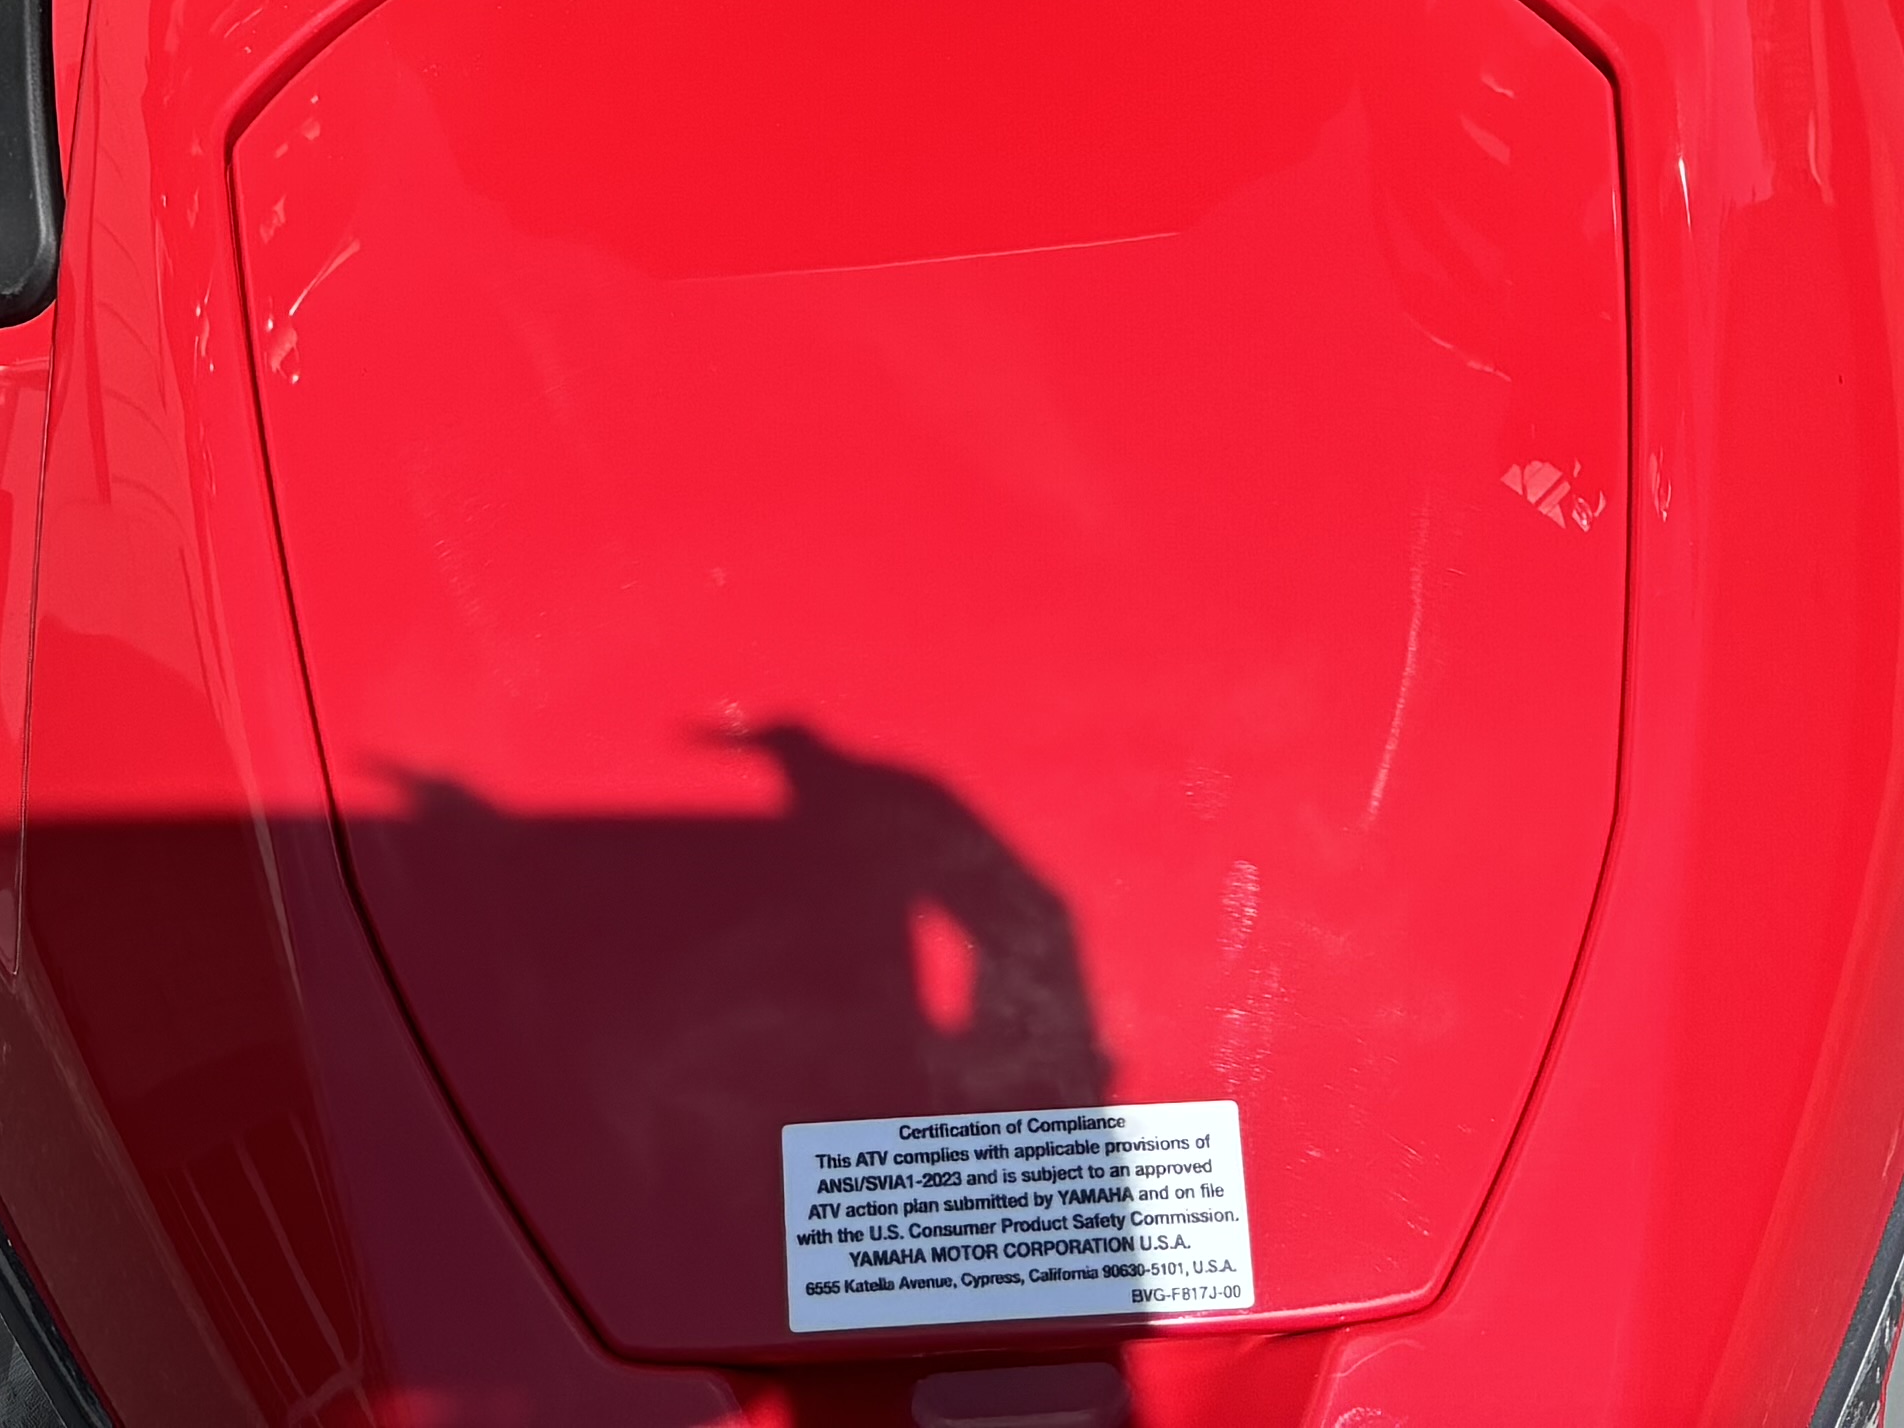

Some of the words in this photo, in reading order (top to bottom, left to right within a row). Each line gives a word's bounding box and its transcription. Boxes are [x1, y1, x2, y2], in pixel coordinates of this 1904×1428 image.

[898, 1121, 1001, 1140] Certification
[1004, 1118, 1022, 1134] of
[1026, 1115, 1125, 1134] Compliance
[814, 1153, 851, 1169] This
[854, 1149, 888, 1167] ATV
[892, 1146, 969, 1165] complies
[973, 1143, 1009, 1160] with
[1013, 1139, 1100, 1161] applicable
[1104, 1136, 1189, 1156] provisions
[1194, 1133, 1210, 1149] of
[817, 1170, 962, 1193] ANSI/SVIA1-2023
[965, 1168, 998, 1186] and
[1001, 1167, 1017, 1184] is
[1020, 1164, 1083, 1184] subject
[1086, 1164, 1105, 1179] to
[1108, 1164, 1130, 1178] an
[1134, 1158, 1212, 1179] approved
[807, 1202, 841, 1220] ATV
[845, 1200, 898, 1218] action
[902, 1197, 939, 1217] plan
[943, 1191, 1029, 1211] submitted
[1032, 1191, 1053, 1210] by
[1057, 1186, 1134, 1205] YAMAHA
[1138, 1184, 1169, 1201] and
[1174, 1187, 1195, 1199] on
[1199, 1182, 1224, 1198] file
[796, 1228, 833, 1246] with
[836, 1226, 864, 1243] the
[868, 1223, 904, 1241] U.S.
[908, 1221, 996, 1239] Consumer
[1000, 1215, 1068, 1233] Product
[1071, 1212, 1125, 1231] Safety
[1129, 1208, 1238, 1226] Commission.
[849, 1247, 926, 1267] YAMAHA
[930, 1243, 998, 1262] MOTOR
[1003, 1236, 1134, 1258] CORPORATION
[1139, 1233, 1191, 1251] U.S.A.
[804, 1279, 841, 1296] 6555
[843, 1276, 895, 1293] Katella
[898, 1275, 957, 1290] Avenue,
[960, 1272, 1025, 1288] Cypress,
[1028, 1265, 1099, 1282] California
[1101, 1261, 1189, 1278] 90630-5101,
[1192, 1258, 1237, 1274] U.S.A.
[1131, 1284, 1241, 1303] BVG-F817J-00
